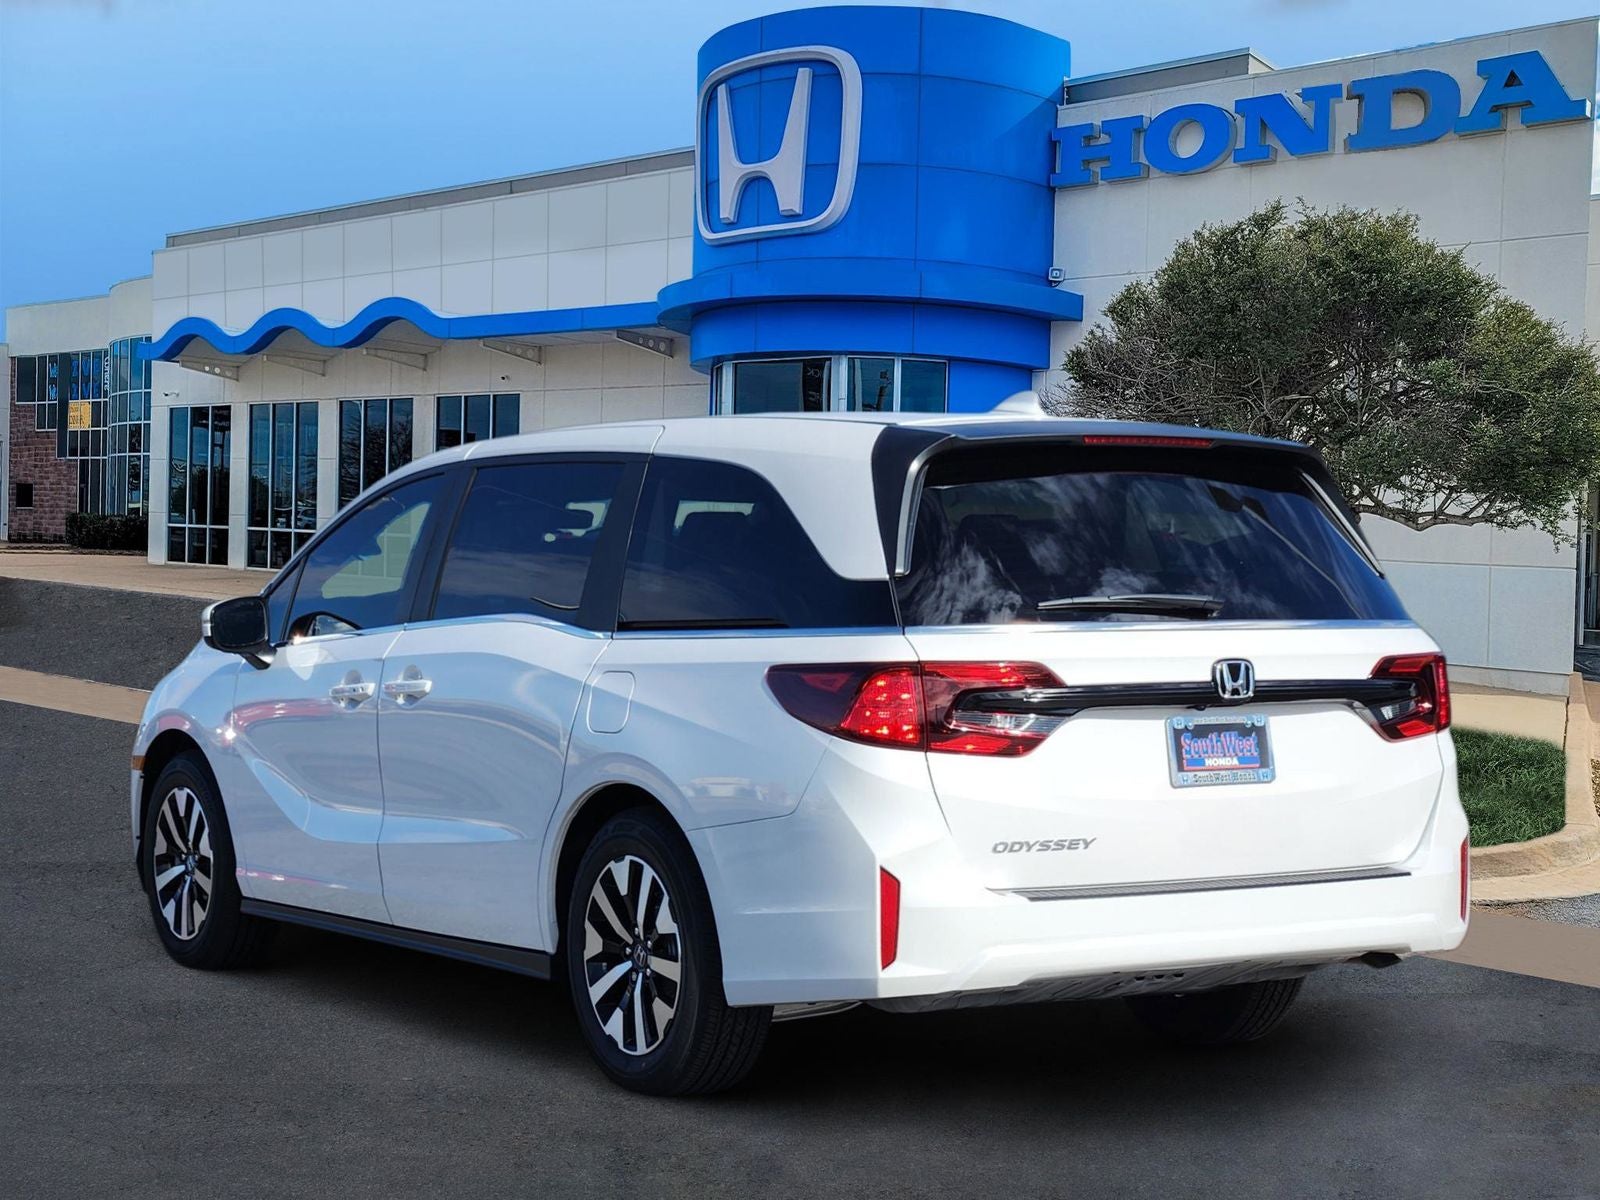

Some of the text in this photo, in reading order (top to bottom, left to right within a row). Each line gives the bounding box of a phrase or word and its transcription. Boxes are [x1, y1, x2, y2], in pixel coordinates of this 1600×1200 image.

[1050, 50, 1591, 188] HONDA
[1204, 757, 1240, 767] HONDA
[991, 837, 1097, 854] ODYSSEY
